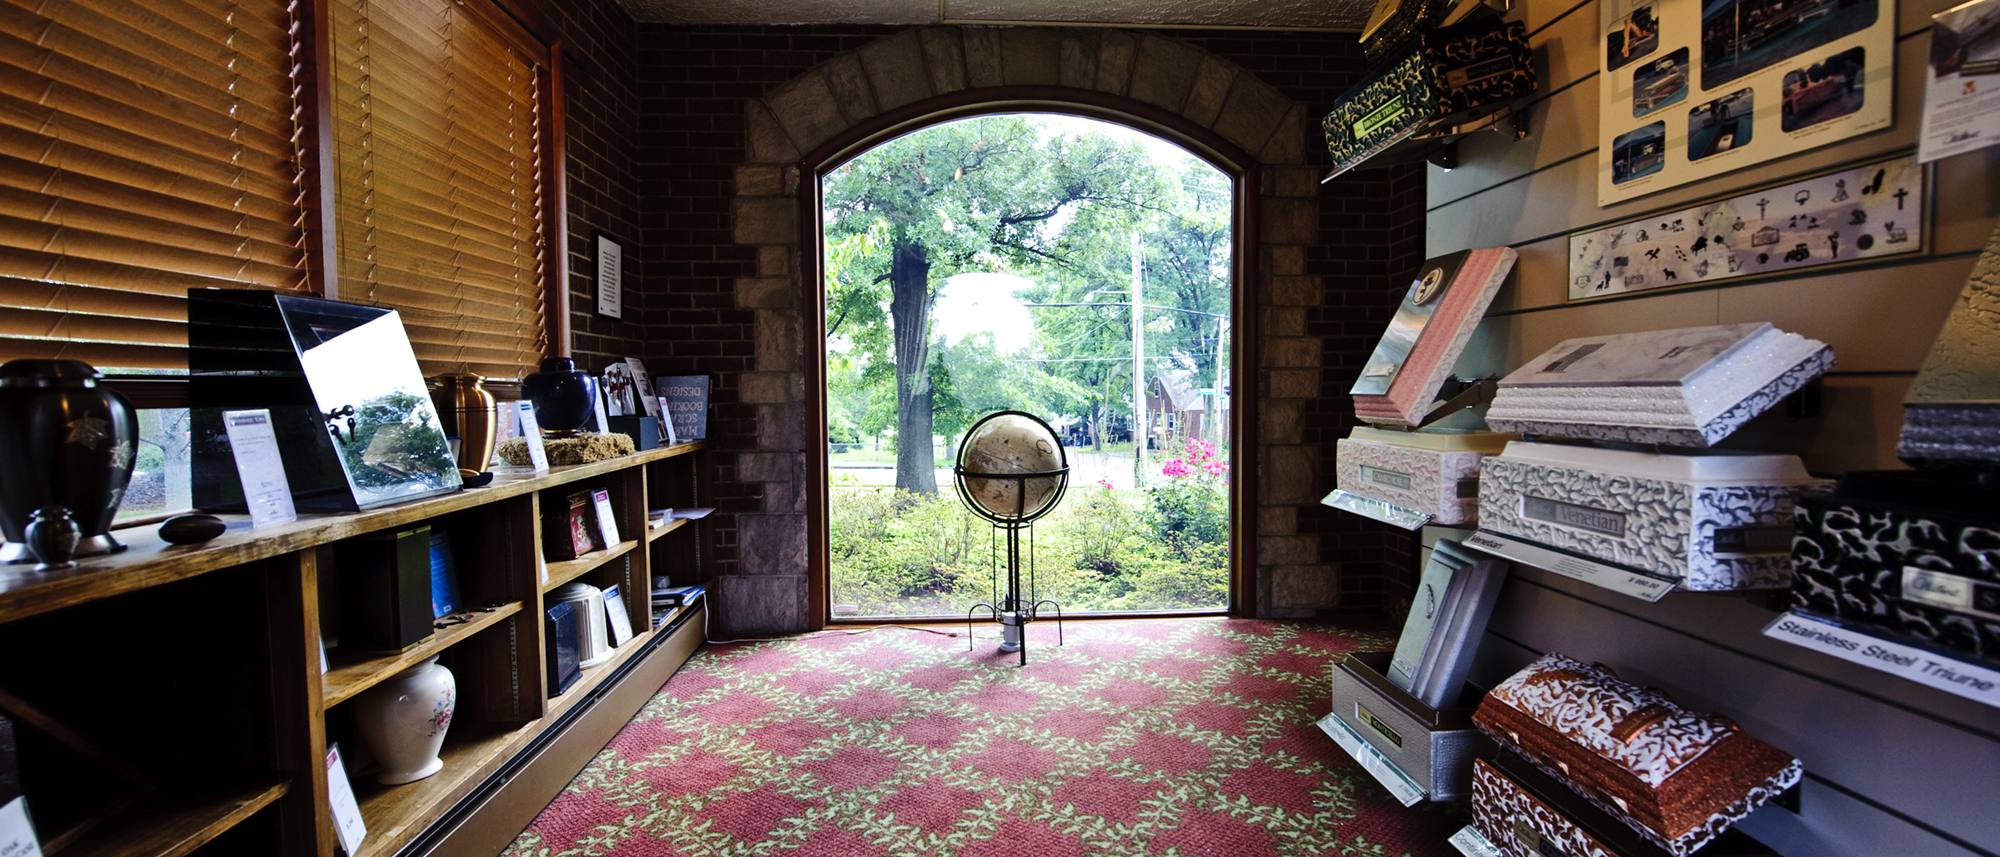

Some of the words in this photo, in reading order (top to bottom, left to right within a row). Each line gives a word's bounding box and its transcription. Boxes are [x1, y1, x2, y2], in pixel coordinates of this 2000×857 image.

[1560, 505, 1619, 532] Venetian
[1470, 535, 1504, 550] Venetian
[1777, 620, 1860, 652] Stainless
[1861, 644, 1917, 668] Steel
[1921, 660, 1995, 692] Triune
